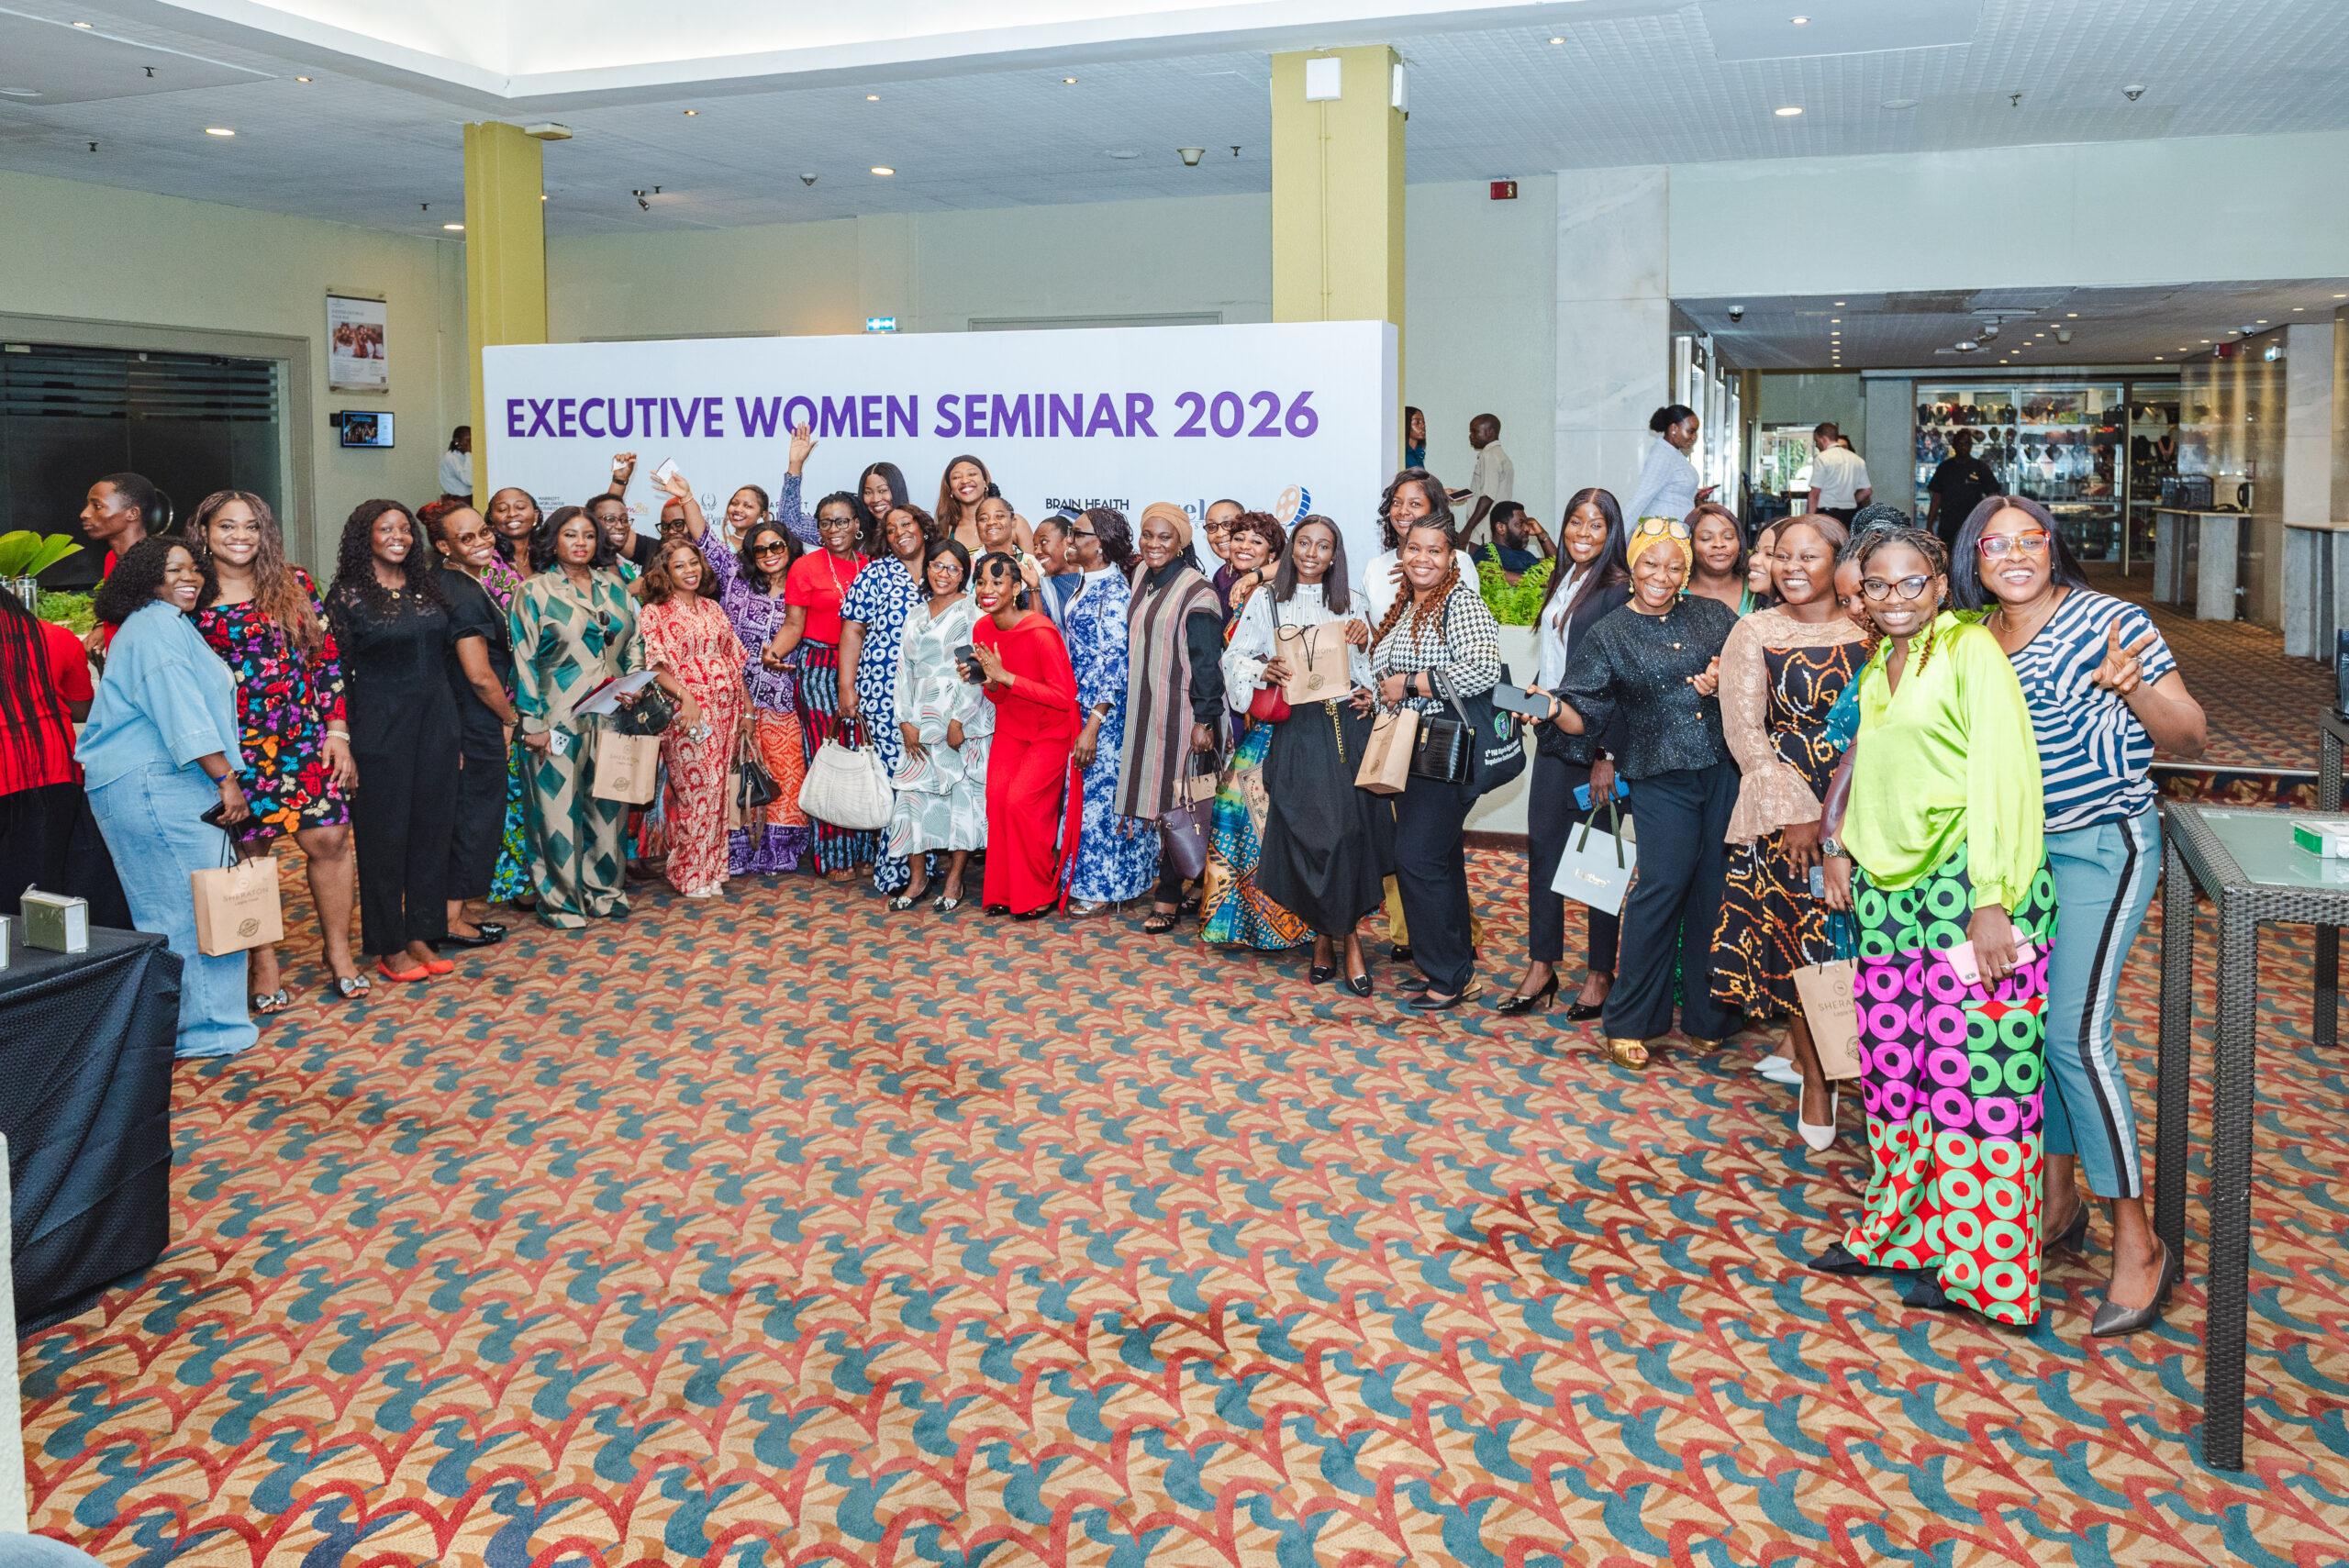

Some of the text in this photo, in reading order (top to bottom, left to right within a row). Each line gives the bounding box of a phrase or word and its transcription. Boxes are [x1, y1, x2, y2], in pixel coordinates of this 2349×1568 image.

[507, 390, 1319, 439] EXECUTIVE WOMEN SEMINAR 2026
[1045, 498, 1130, 510] BRAIN HEALTH
[223, 887, 269, 902] SHERATON
[1818, 998, 1854, 1011] SHERA
